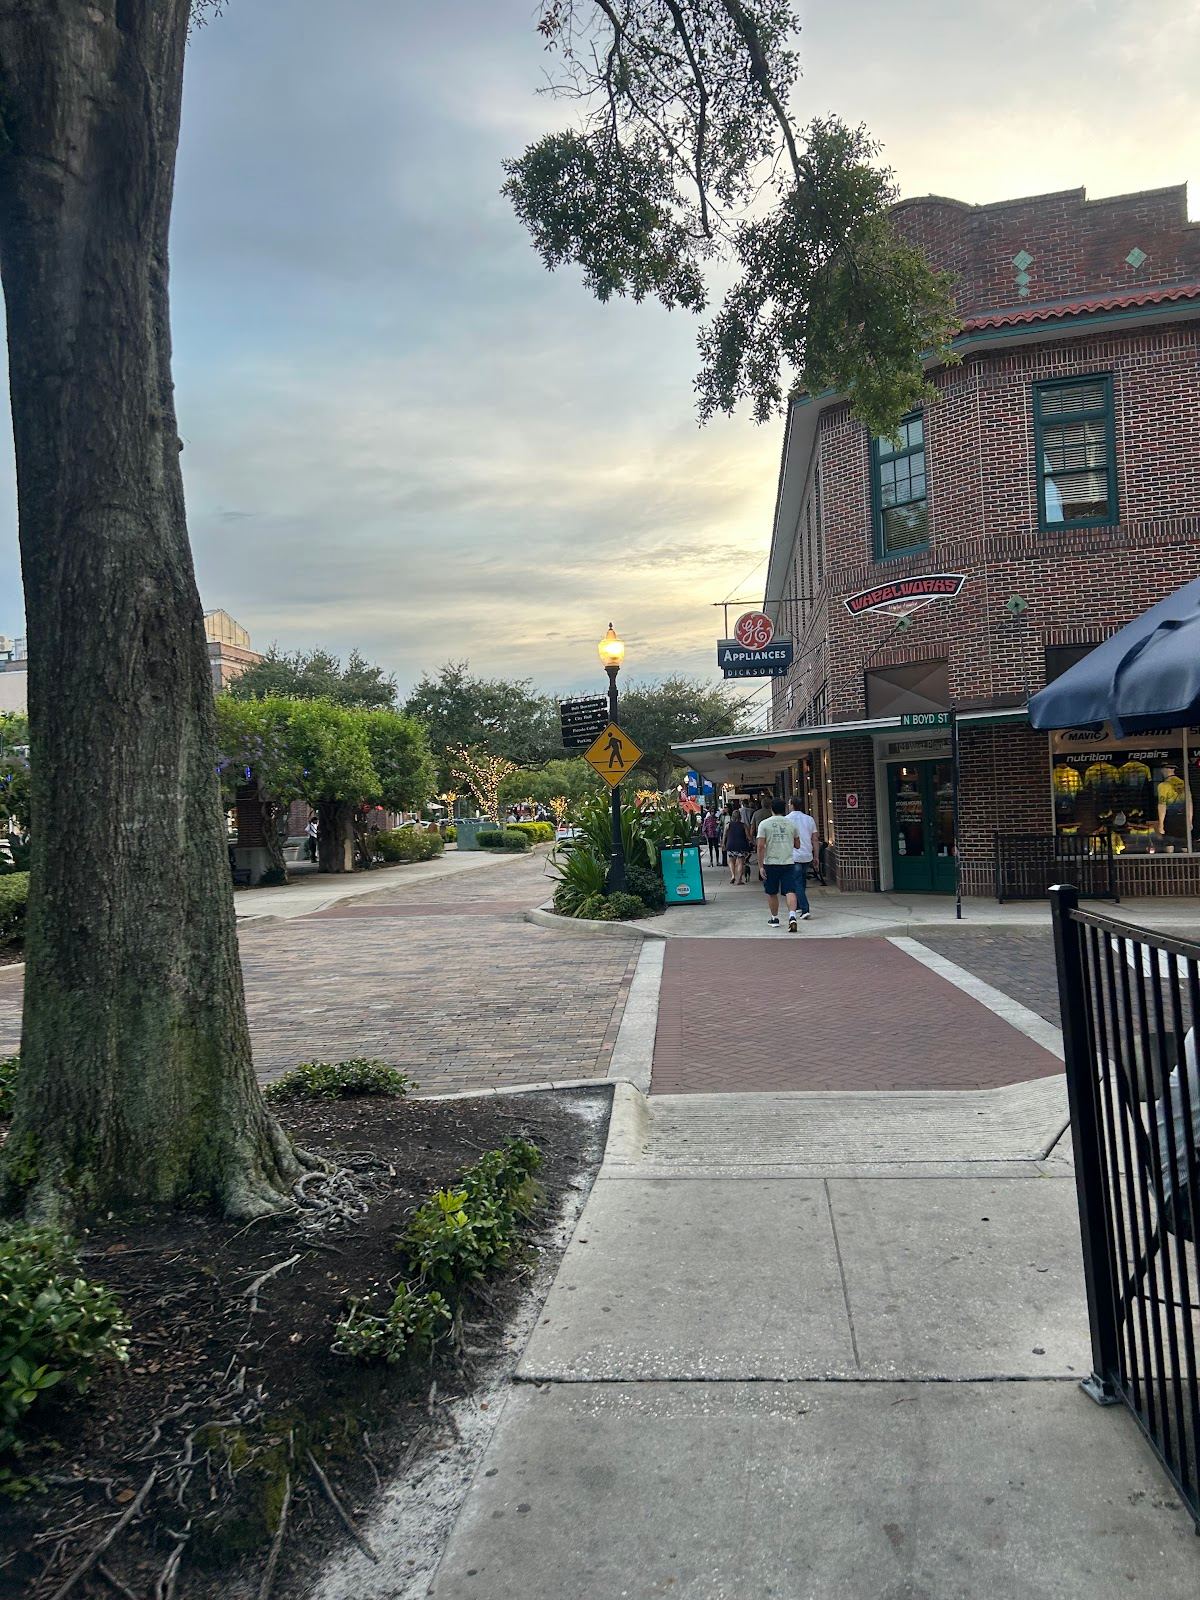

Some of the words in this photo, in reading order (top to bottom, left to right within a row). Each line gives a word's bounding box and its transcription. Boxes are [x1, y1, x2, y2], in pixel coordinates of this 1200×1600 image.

[724, 650, 786, 661] APPLIANCES
[903, 715, 910, 725] N
[912, 714, 935, 725] BOYD
[937, 713, 949, 724] ST
[1068, 731, 1101, 741] MAVIC
[1066, 752, 1112, 763] nutrition
[1128, 750, 1168, 760] repairs
